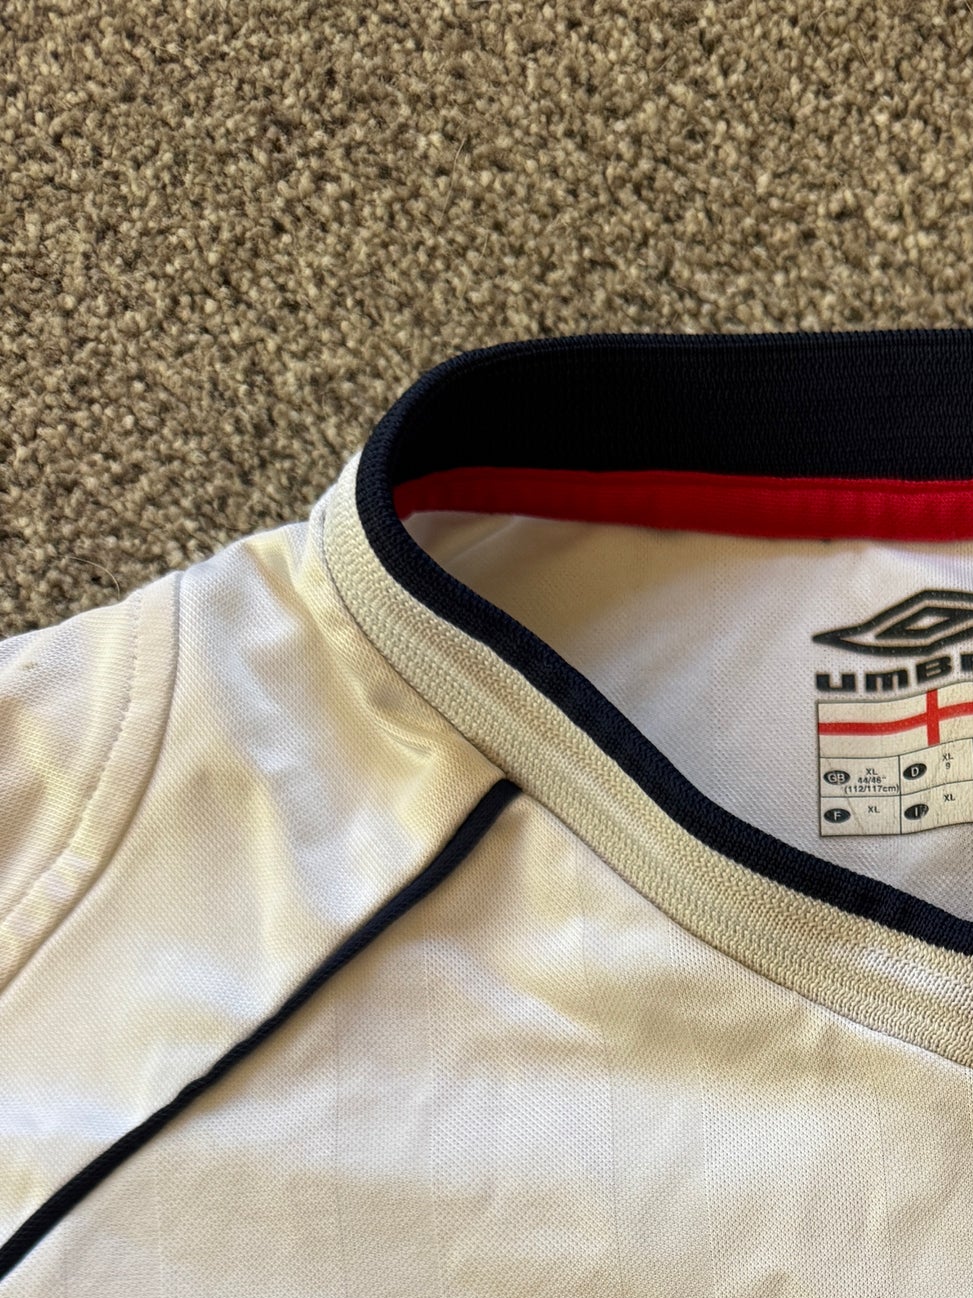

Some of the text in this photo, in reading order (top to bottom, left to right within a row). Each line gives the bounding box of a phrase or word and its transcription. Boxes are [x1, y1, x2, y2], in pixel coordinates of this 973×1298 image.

[942, 752, 954, 762] XL
[865, 767, 878, 776] XL
[911, 766, 920, 777] D
[827, 773, 845, 783] GB
[844, 784, 900, 794] (112/117cm)
[943, 793, 956, 803] XL
[867, 805, 881, 814] XL
[833, 811, 841, 821] F
